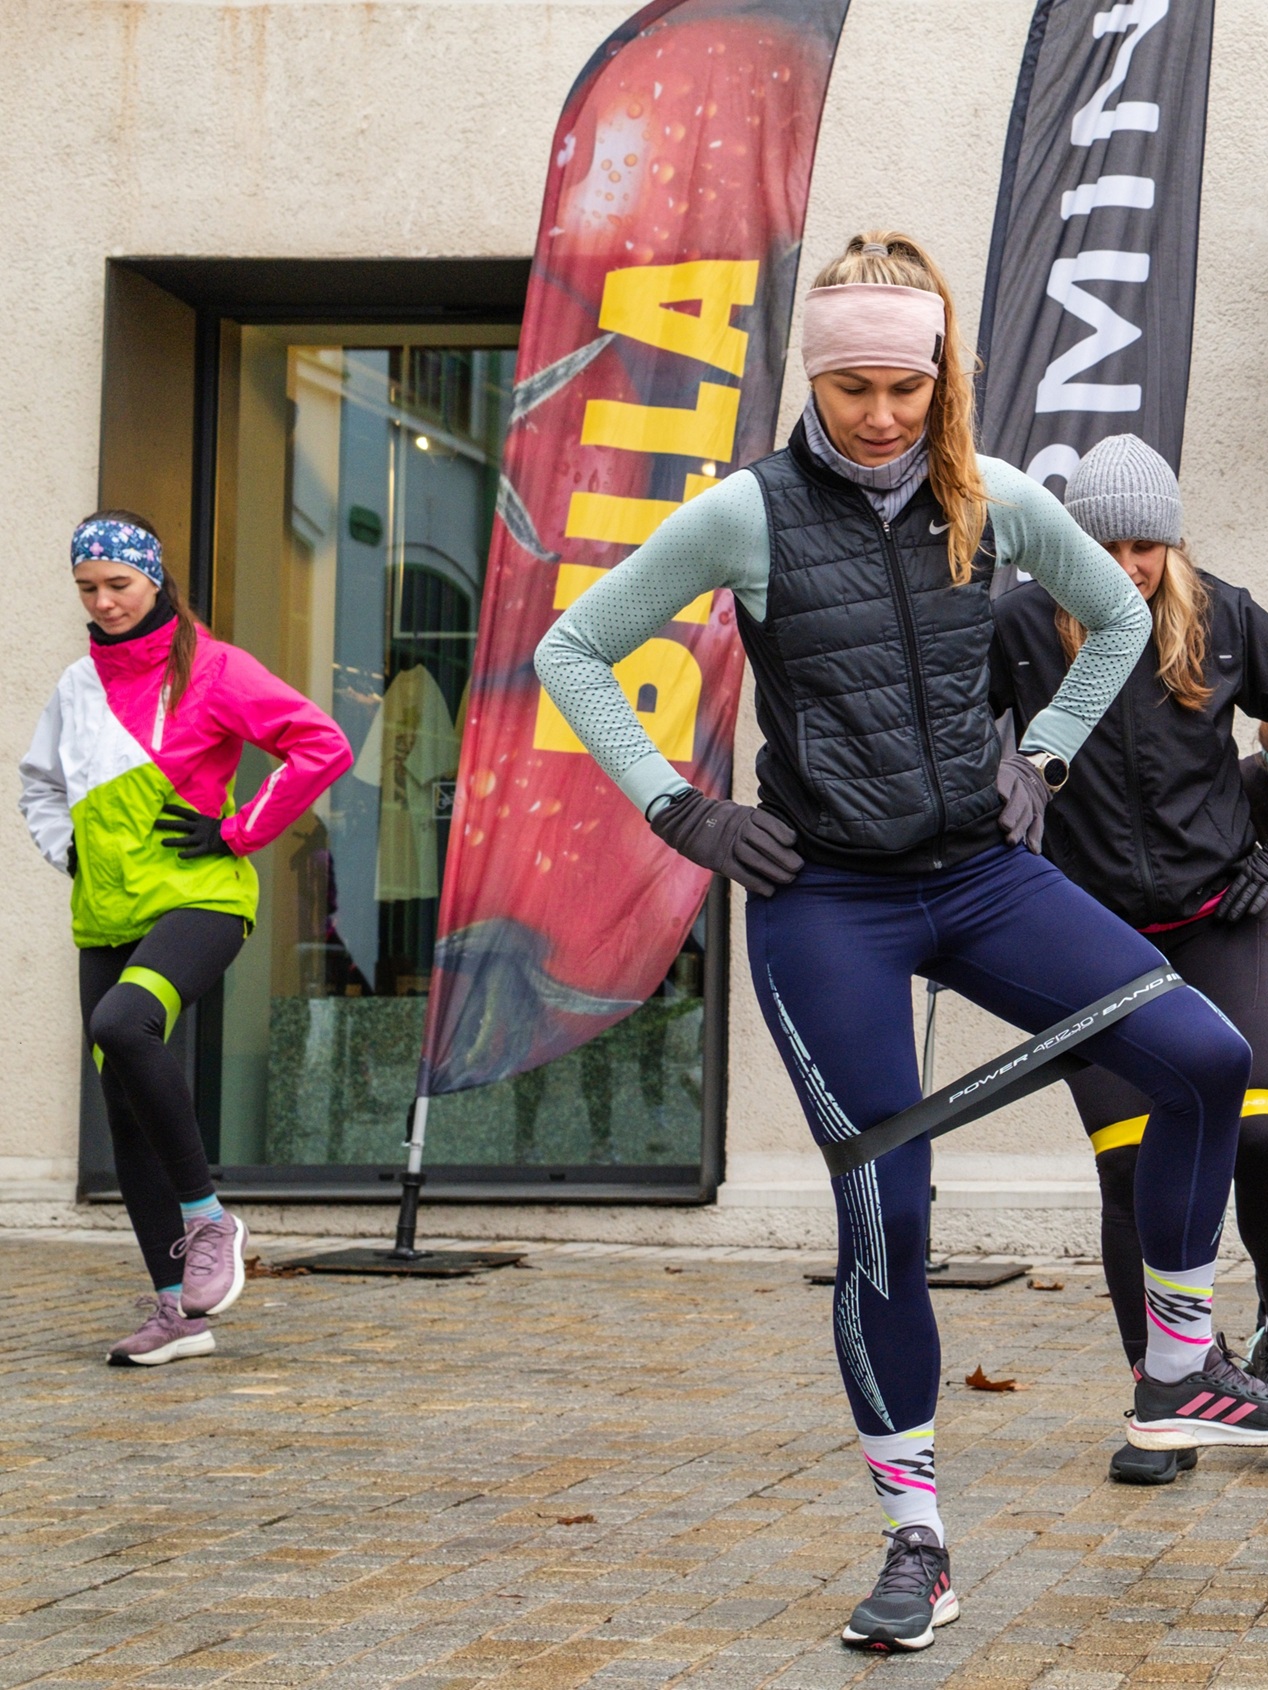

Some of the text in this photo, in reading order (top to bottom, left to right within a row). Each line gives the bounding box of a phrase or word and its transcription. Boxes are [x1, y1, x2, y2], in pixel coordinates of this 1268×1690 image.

[1027, 0, 1169, 500] MIN
[533, 260, 760, 762] BILLA
[949, 1053, 1028, 1104] POWER
[1103, 978, 1164, 1016] BAND
